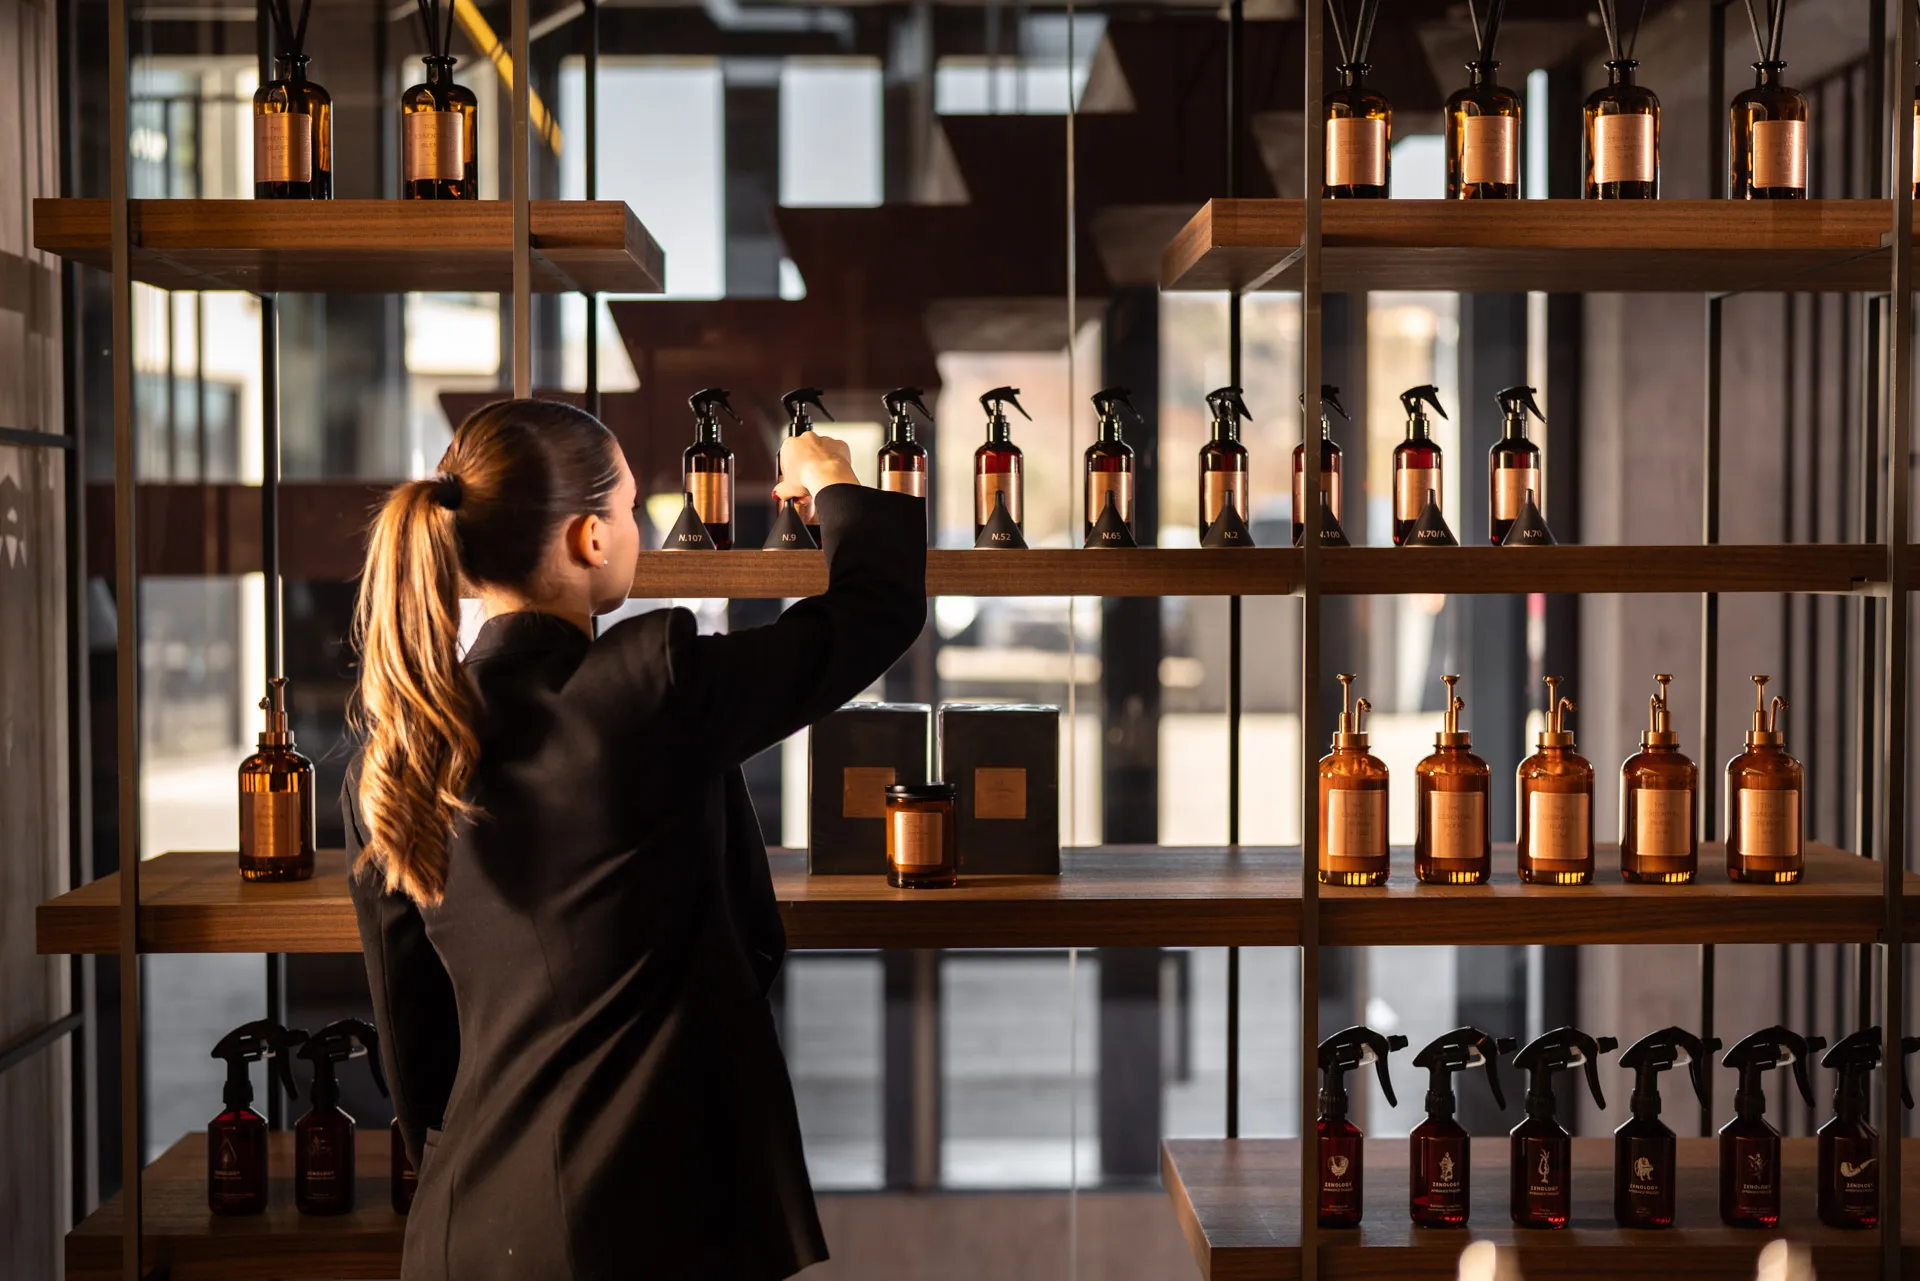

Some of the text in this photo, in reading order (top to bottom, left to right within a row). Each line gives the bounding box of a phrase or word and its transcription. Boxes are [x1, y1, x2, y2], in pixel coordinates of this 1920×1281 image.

[678, 534, 703, 542] N.107
[782, 533, 797, 542] N.9
[991, 532, 1012, 541] N.52
[1102, 531, 1122, 540] N.65
[1224, 531, 1239, 540] N.2
[1417, 530, 1447, 539] N.70/A
[1523, 529, 1543, 538] N.70
